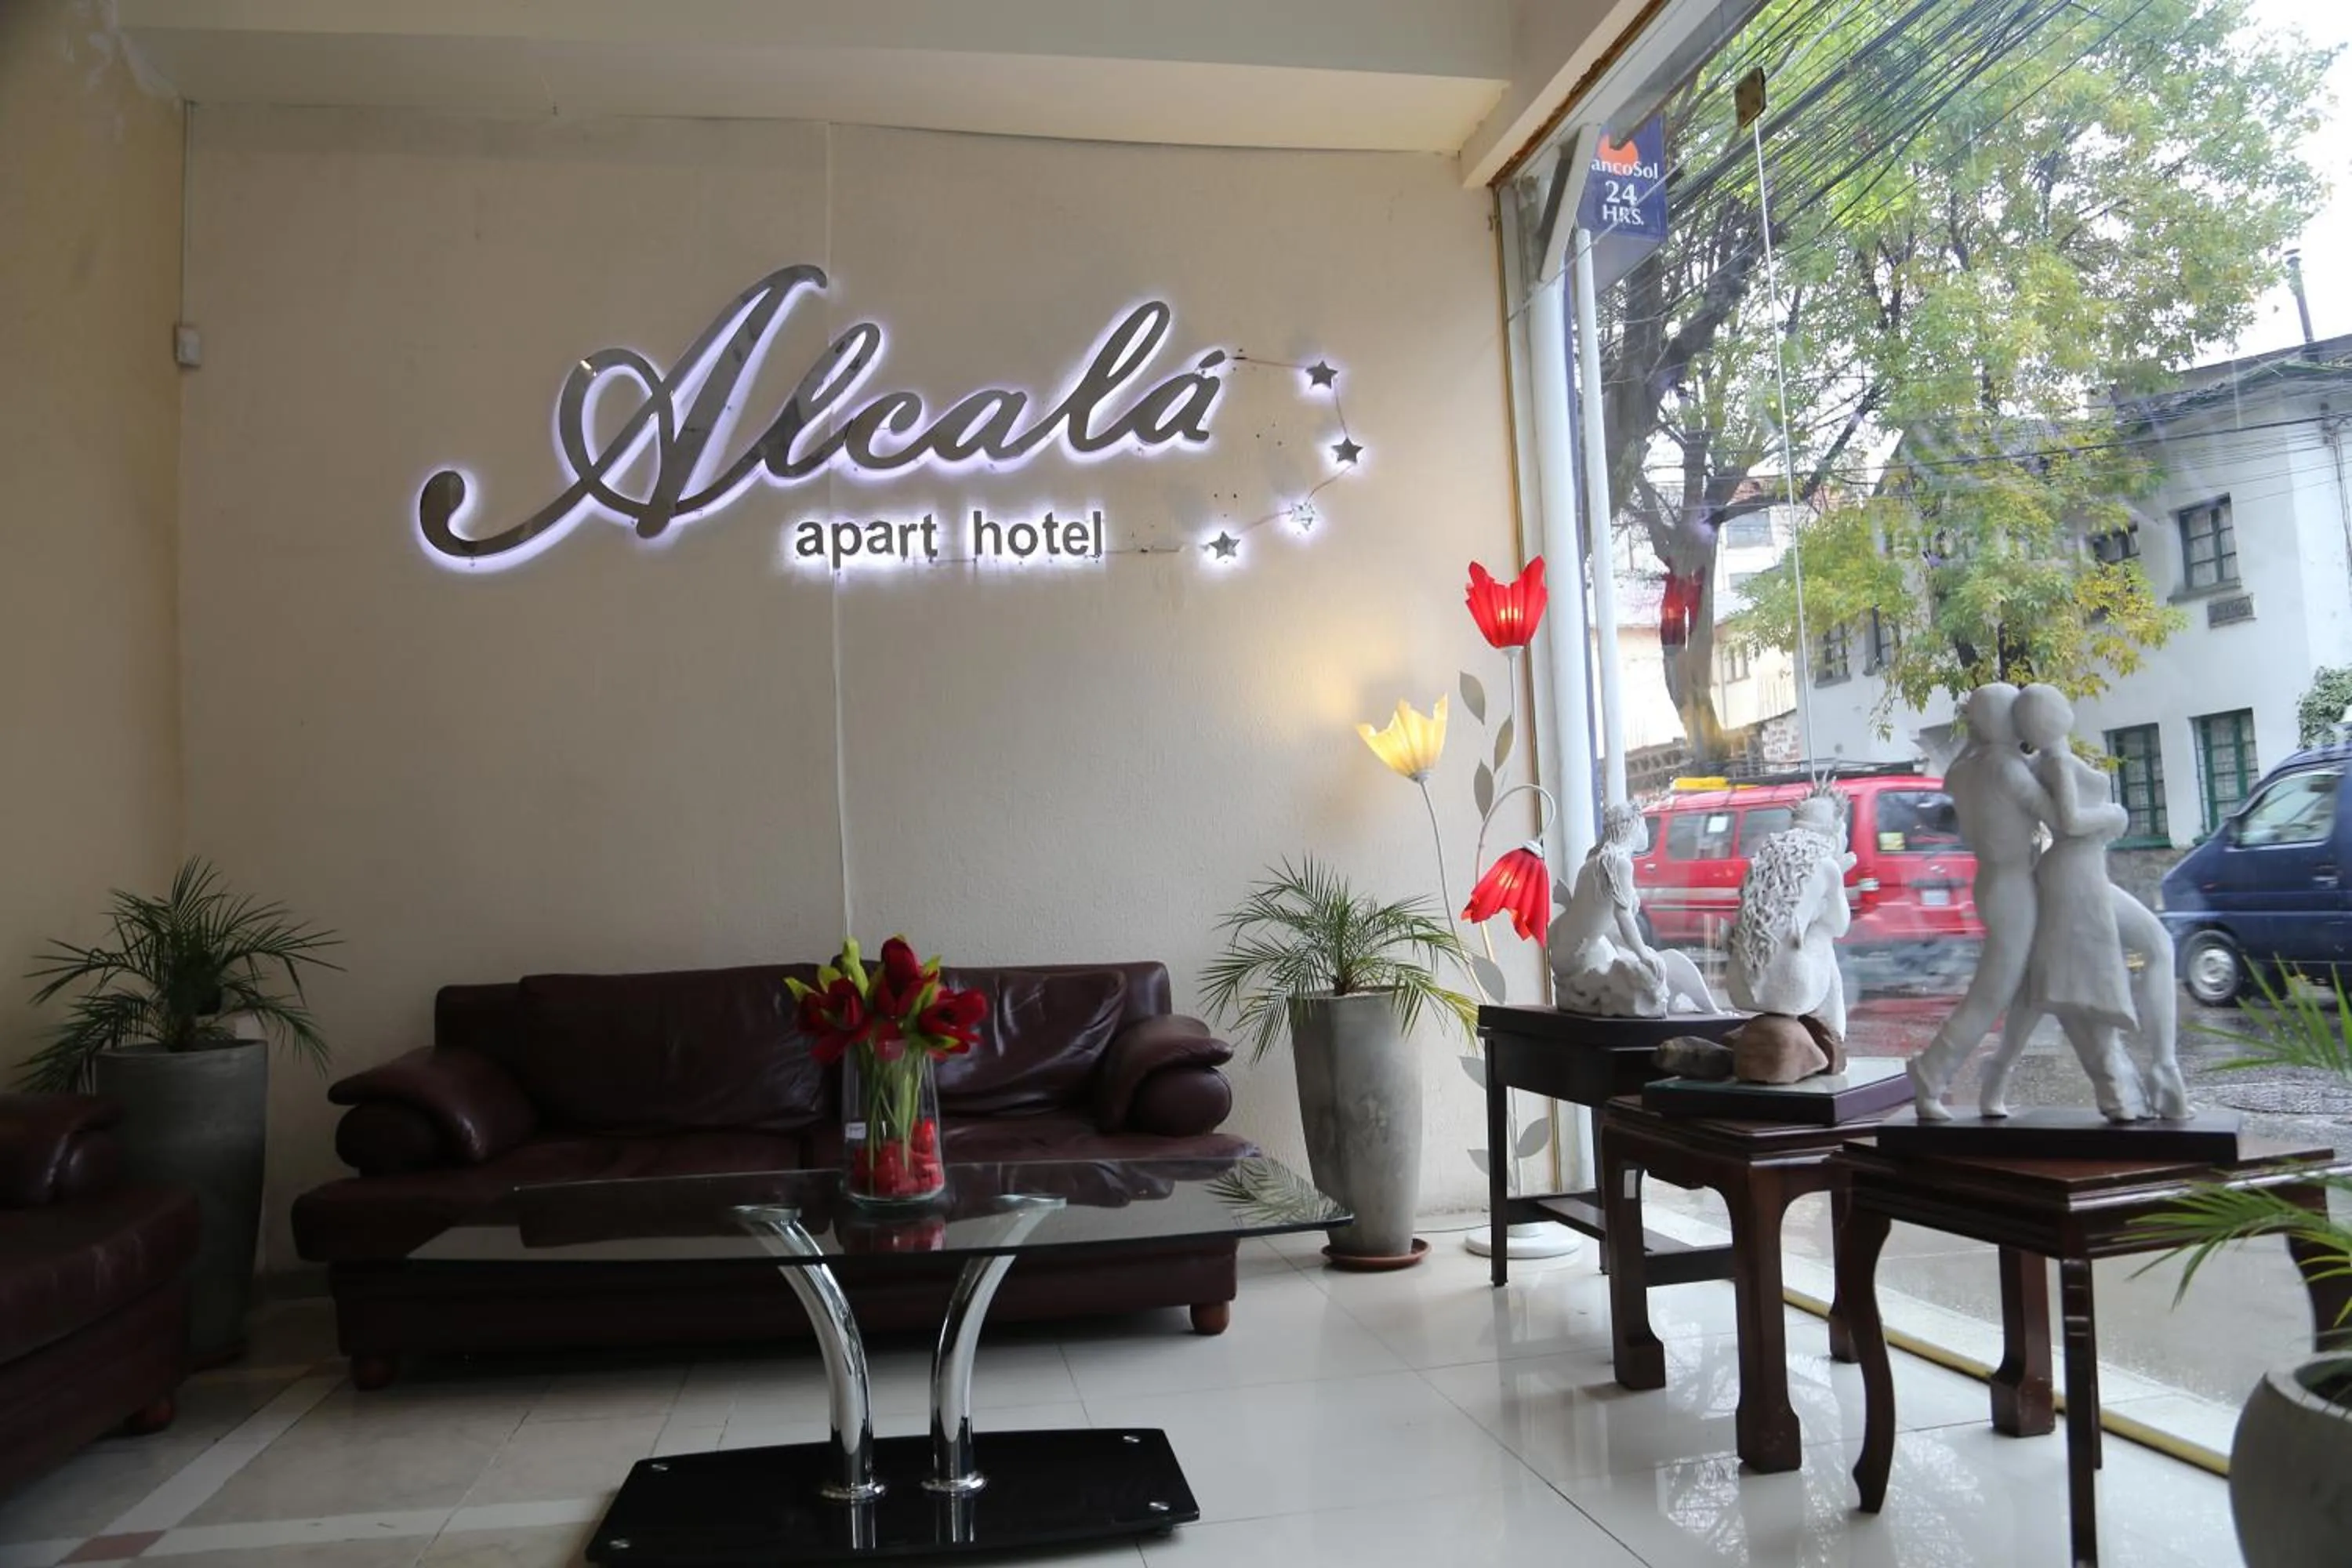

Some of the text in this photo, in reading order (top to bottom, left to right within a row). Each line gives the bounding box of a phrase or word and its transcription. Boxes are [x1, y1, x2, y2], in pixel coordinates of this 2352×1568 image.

[1591, 159, 1658, 179] ancoSol
[1605, 180, 1637, 206] 24
[1602, 205, 1644, 225] HRS.
[419, 265, 1226, 557] Alcalá
[796, 510, 1102, 568] apart hotel
